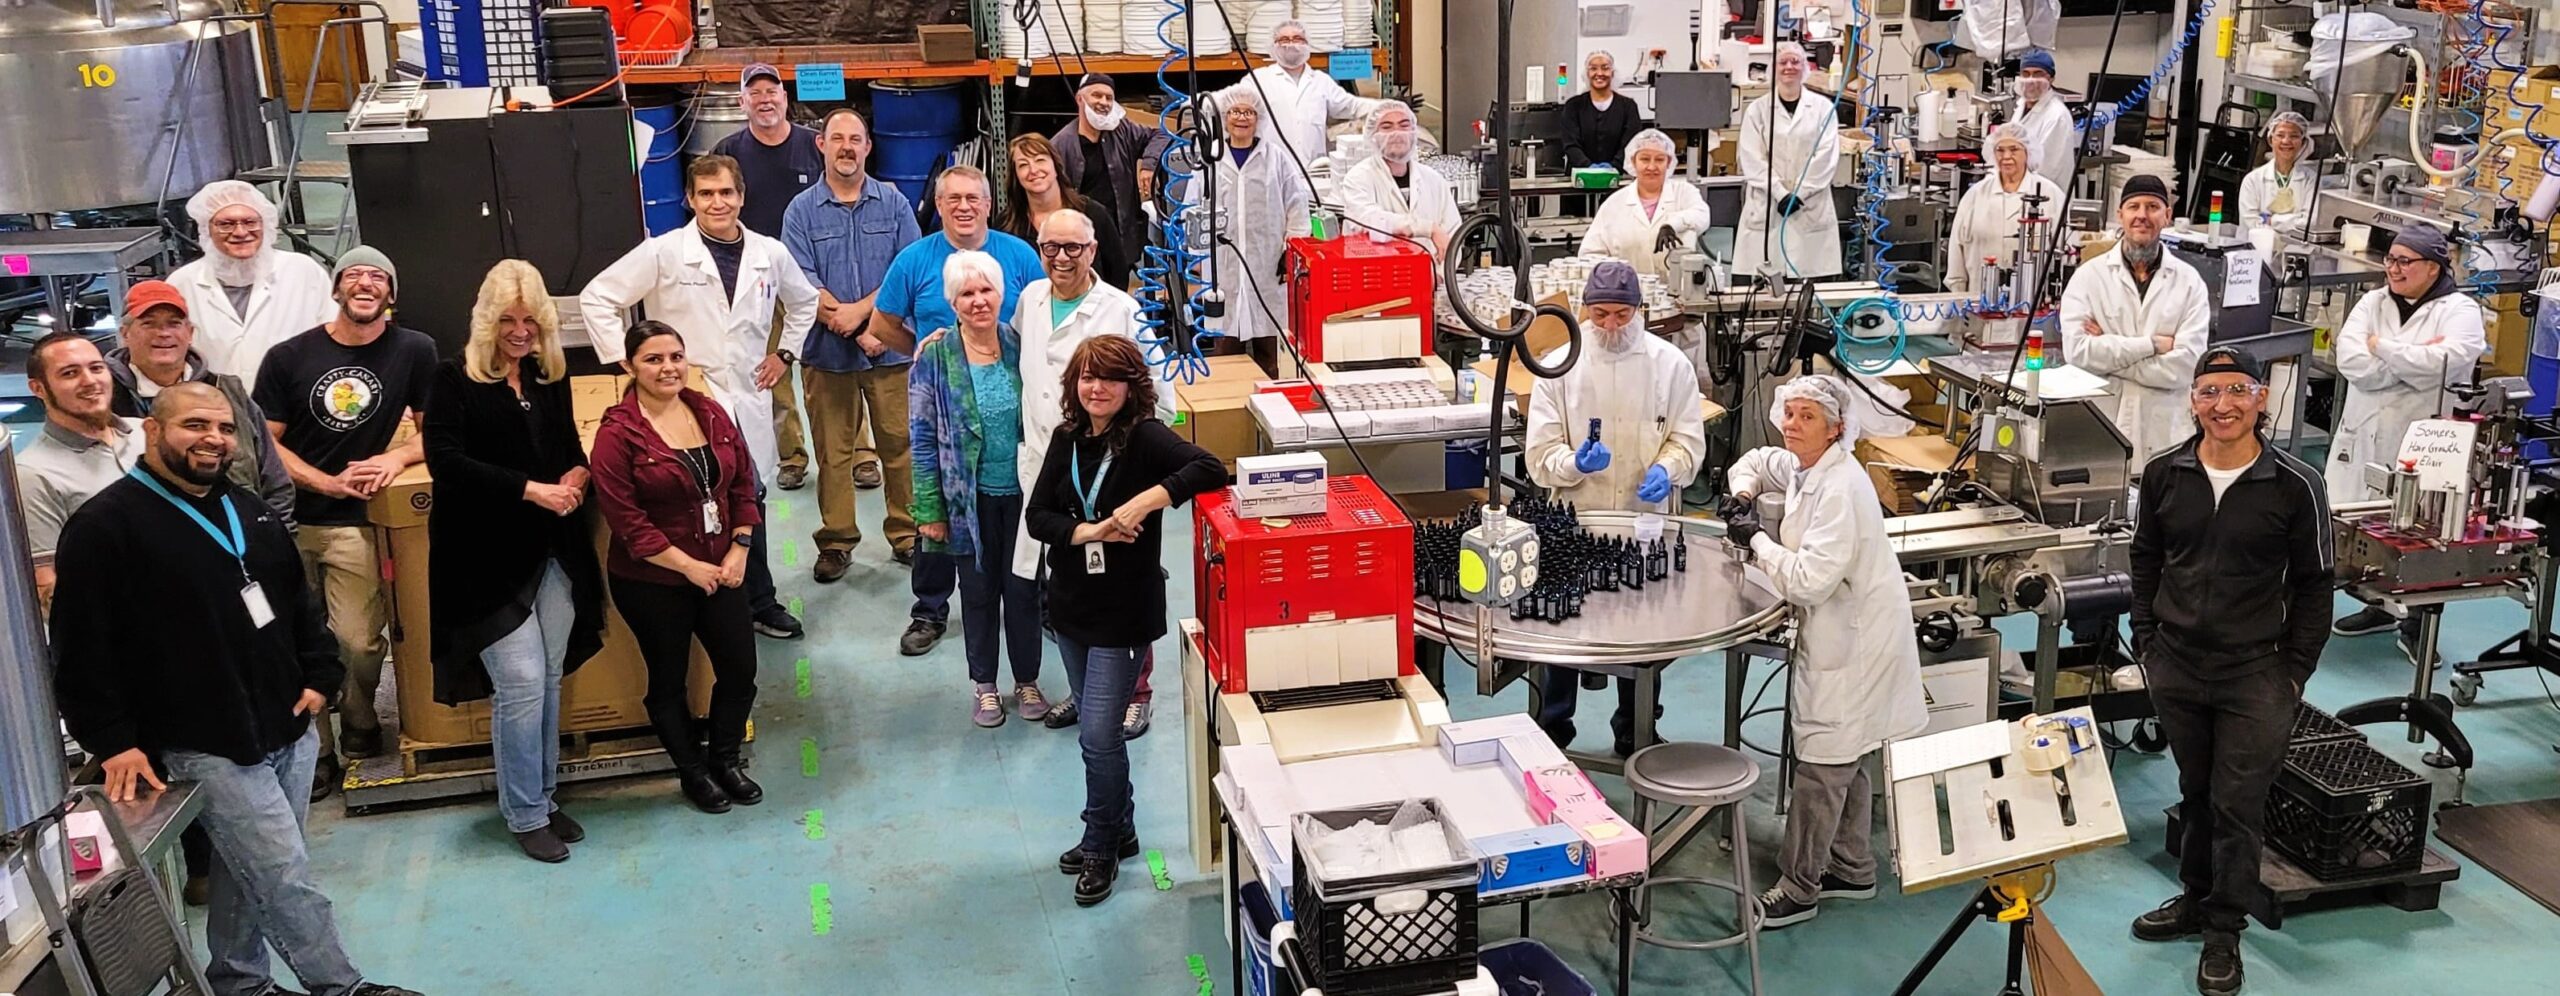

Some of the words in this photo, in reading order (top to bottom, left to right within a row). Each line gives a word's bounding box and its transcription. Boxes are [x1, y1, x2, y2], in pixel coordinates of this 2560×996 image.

[78, 63, 116, 87] 10
[2414, 423, 2457, 439] Somers
[2427, 441, 2461, 454] Growth
[1279, 600, 1290, 619] 3
